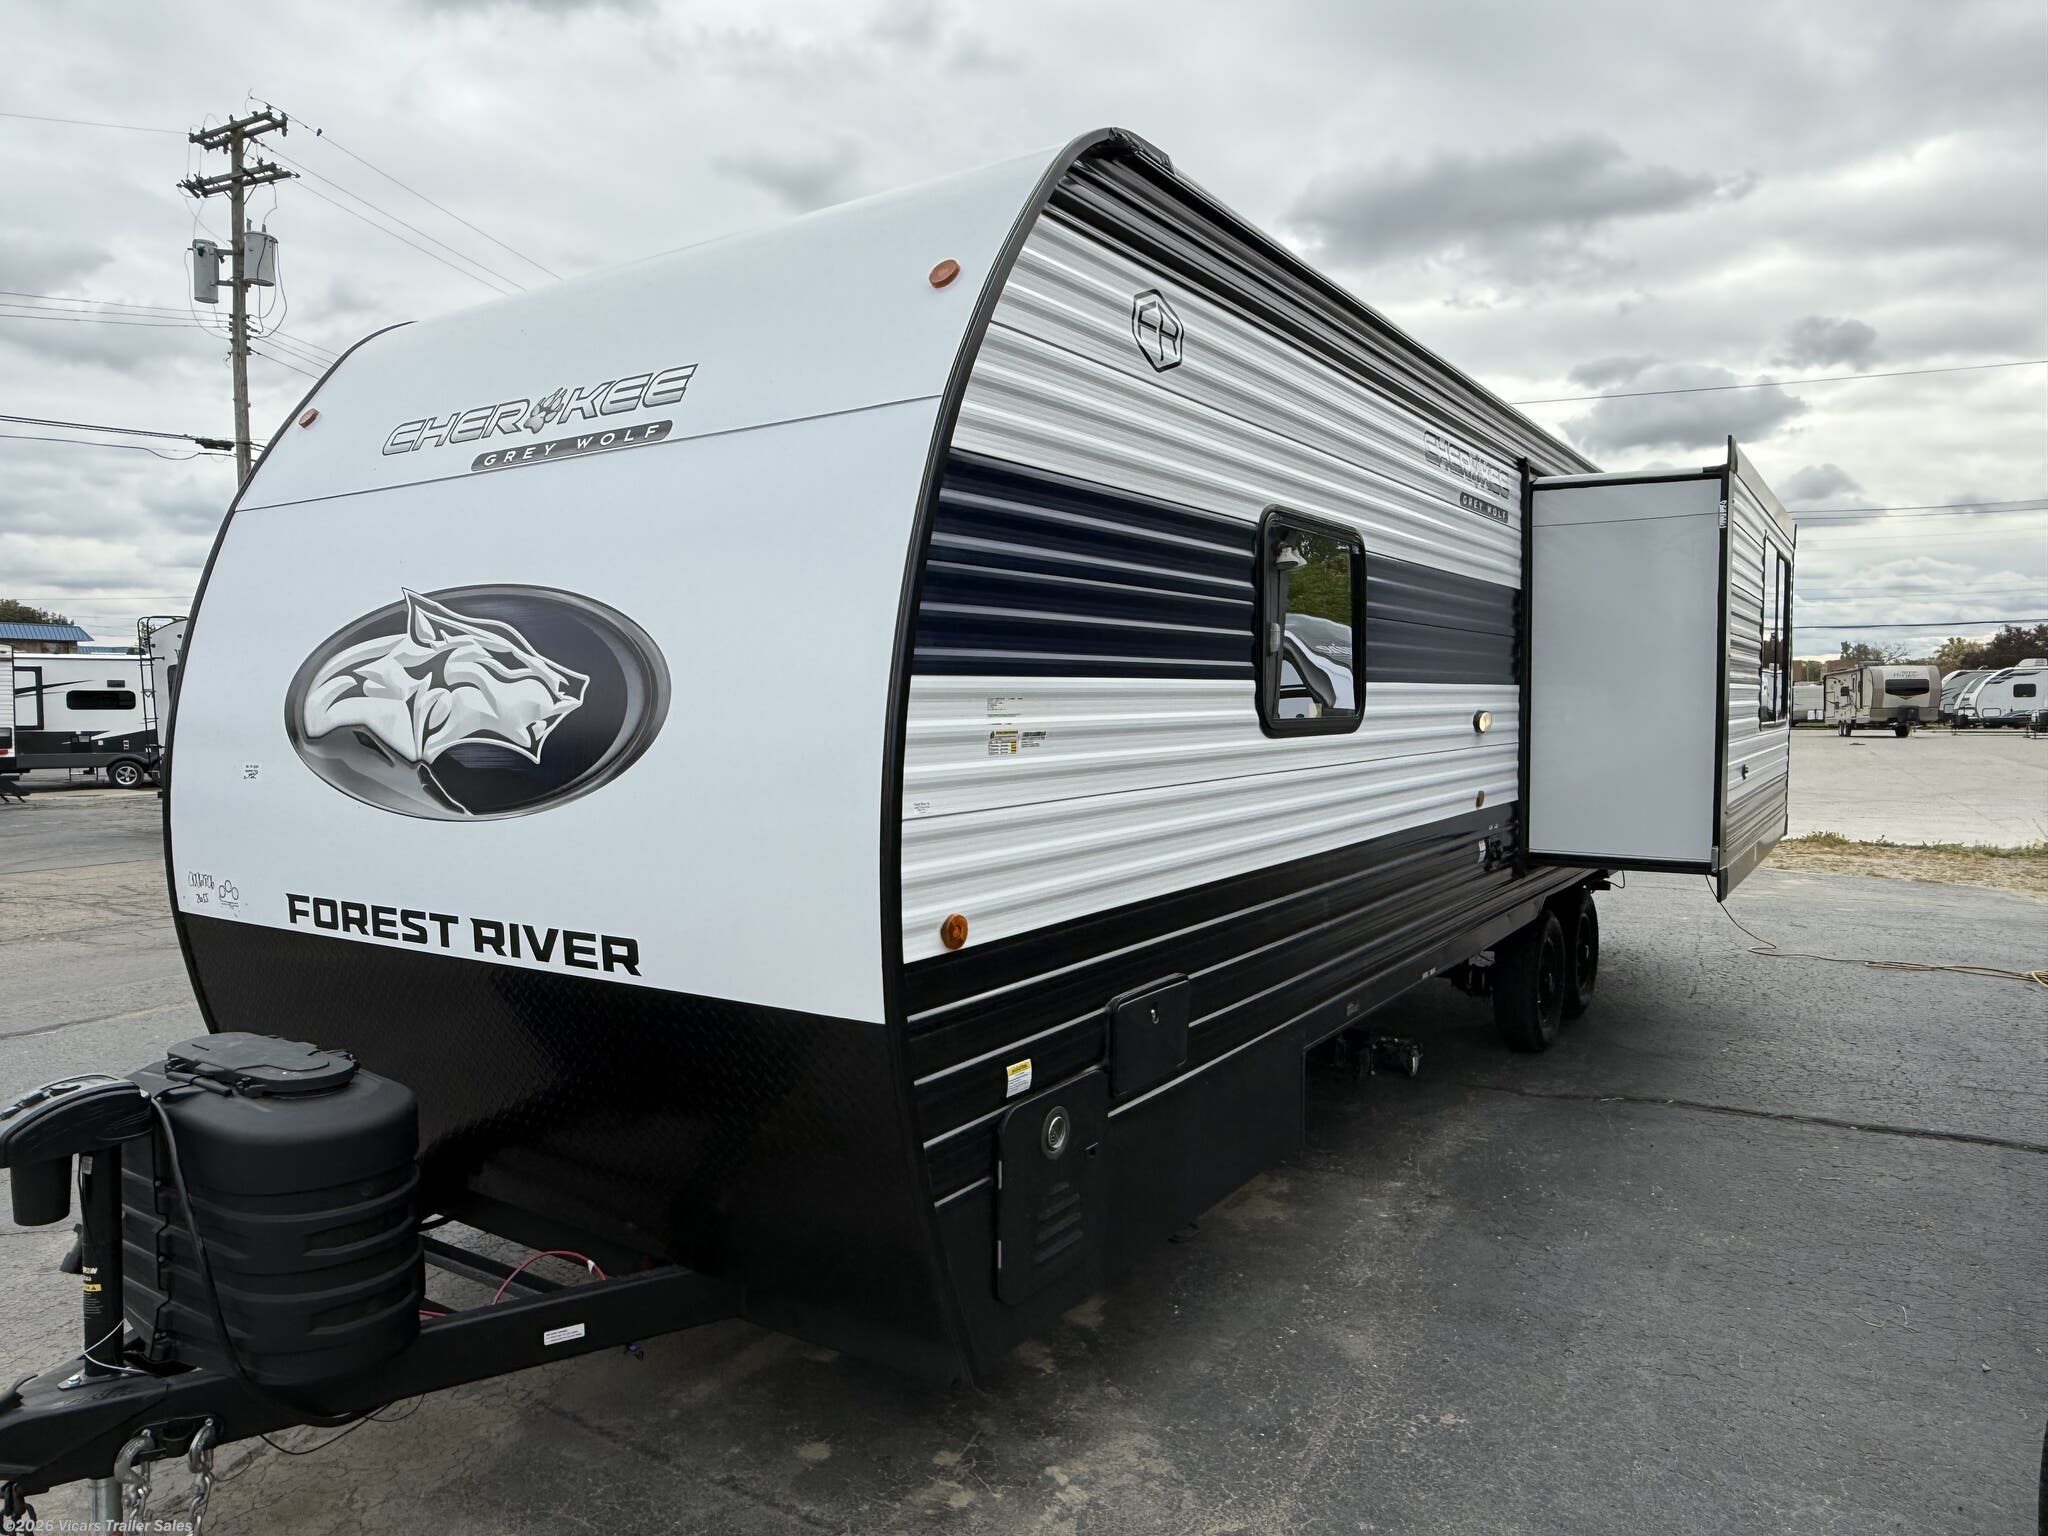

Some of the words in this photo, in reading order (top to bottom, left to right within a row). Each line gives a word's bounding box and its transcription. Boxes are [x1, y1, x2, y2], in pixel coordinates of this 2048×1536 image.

[483, 444, 556, 467] GREY
[576, 424, 661, 450] WOLF
[285, 892, 459, 948] FOREST
[469, 917, 642, 977] RIVER
